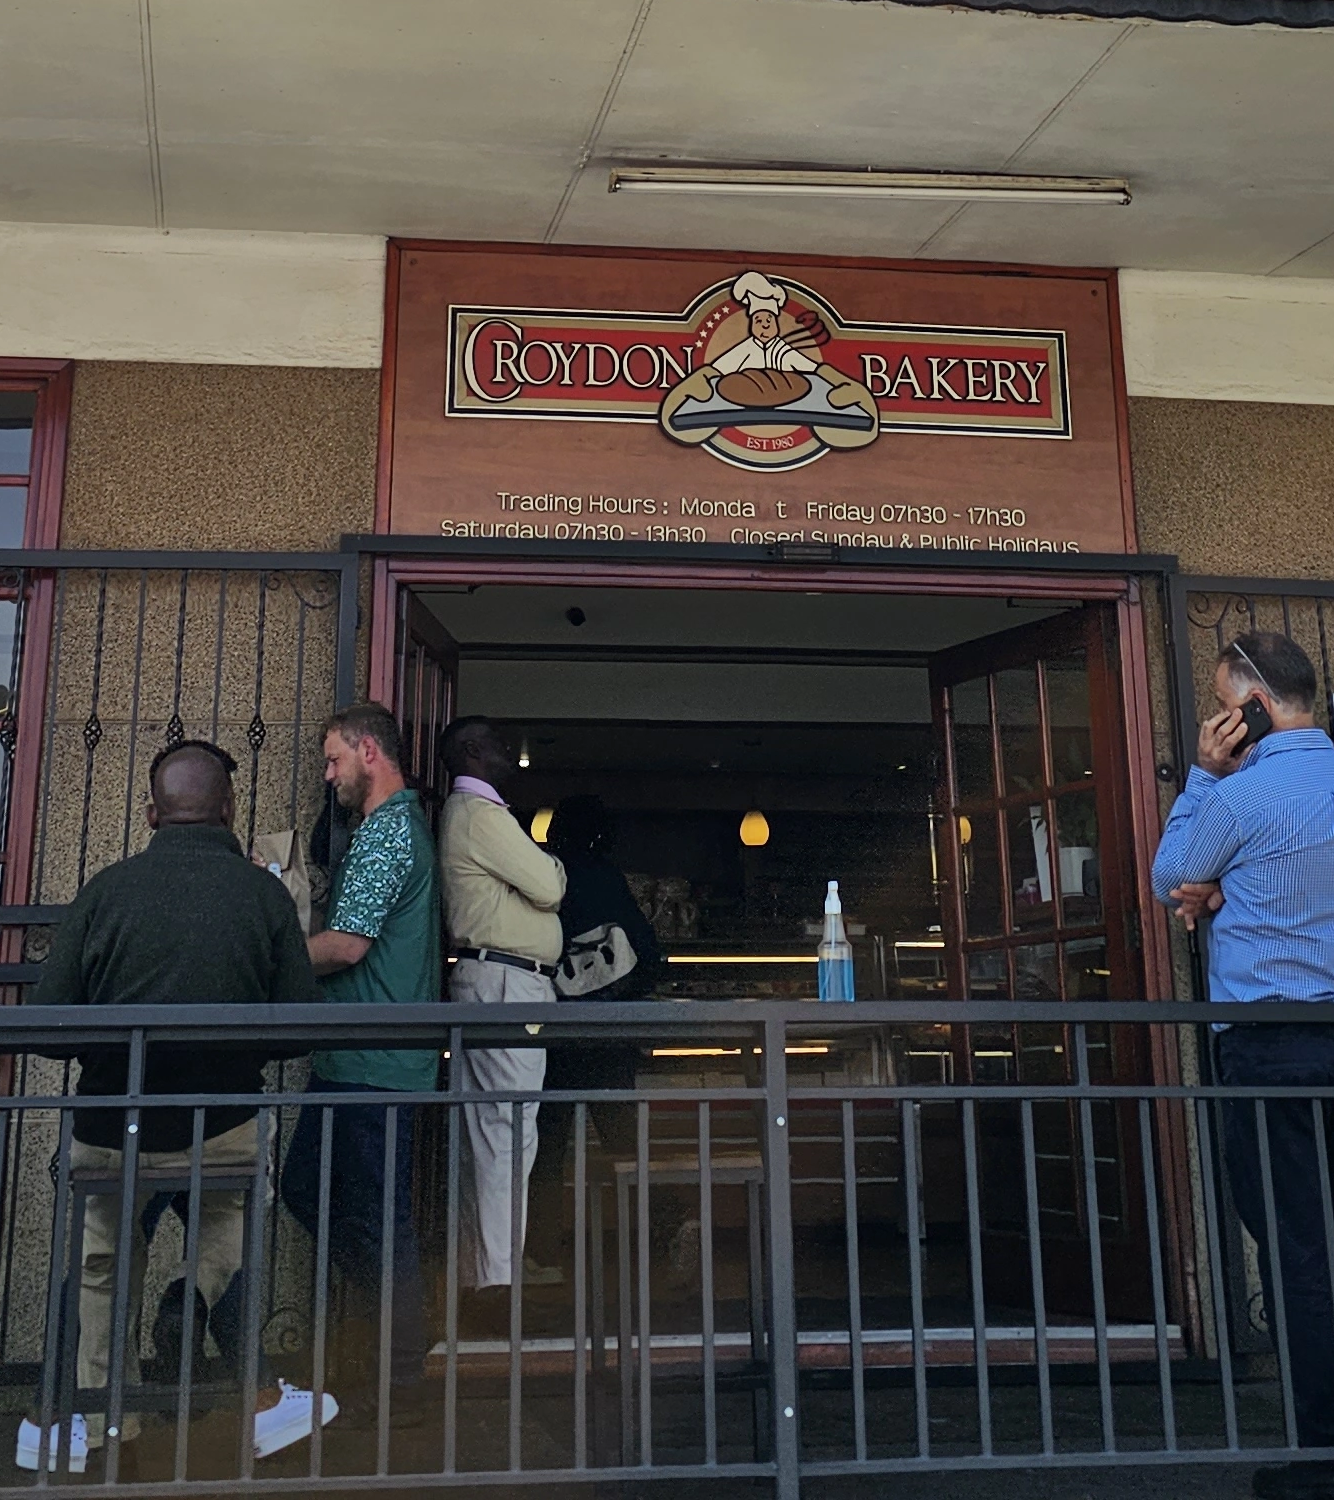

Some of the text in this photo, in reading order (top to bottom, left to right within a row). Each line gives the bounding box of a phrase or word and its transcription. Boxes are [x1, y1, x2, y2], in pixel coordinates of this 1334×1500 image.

[464, 319, 1047, 403] CROYDON BAKERY
[746, 436, 794, 449] EST 1980
[497, 492, 582, 515] Trading
[807, 502, 875, 524] Friday
[881, 504, 947, 524] 07h30
[967, 507, 1025, 527] 17h30
[441, 520, 548, 539] Saturday
[554, 523, 624, 541] 07h30
[646, 526, 706, 543] 13h30
[900, 534, 913, 549] &
[920, 534, 981, 551] Public
